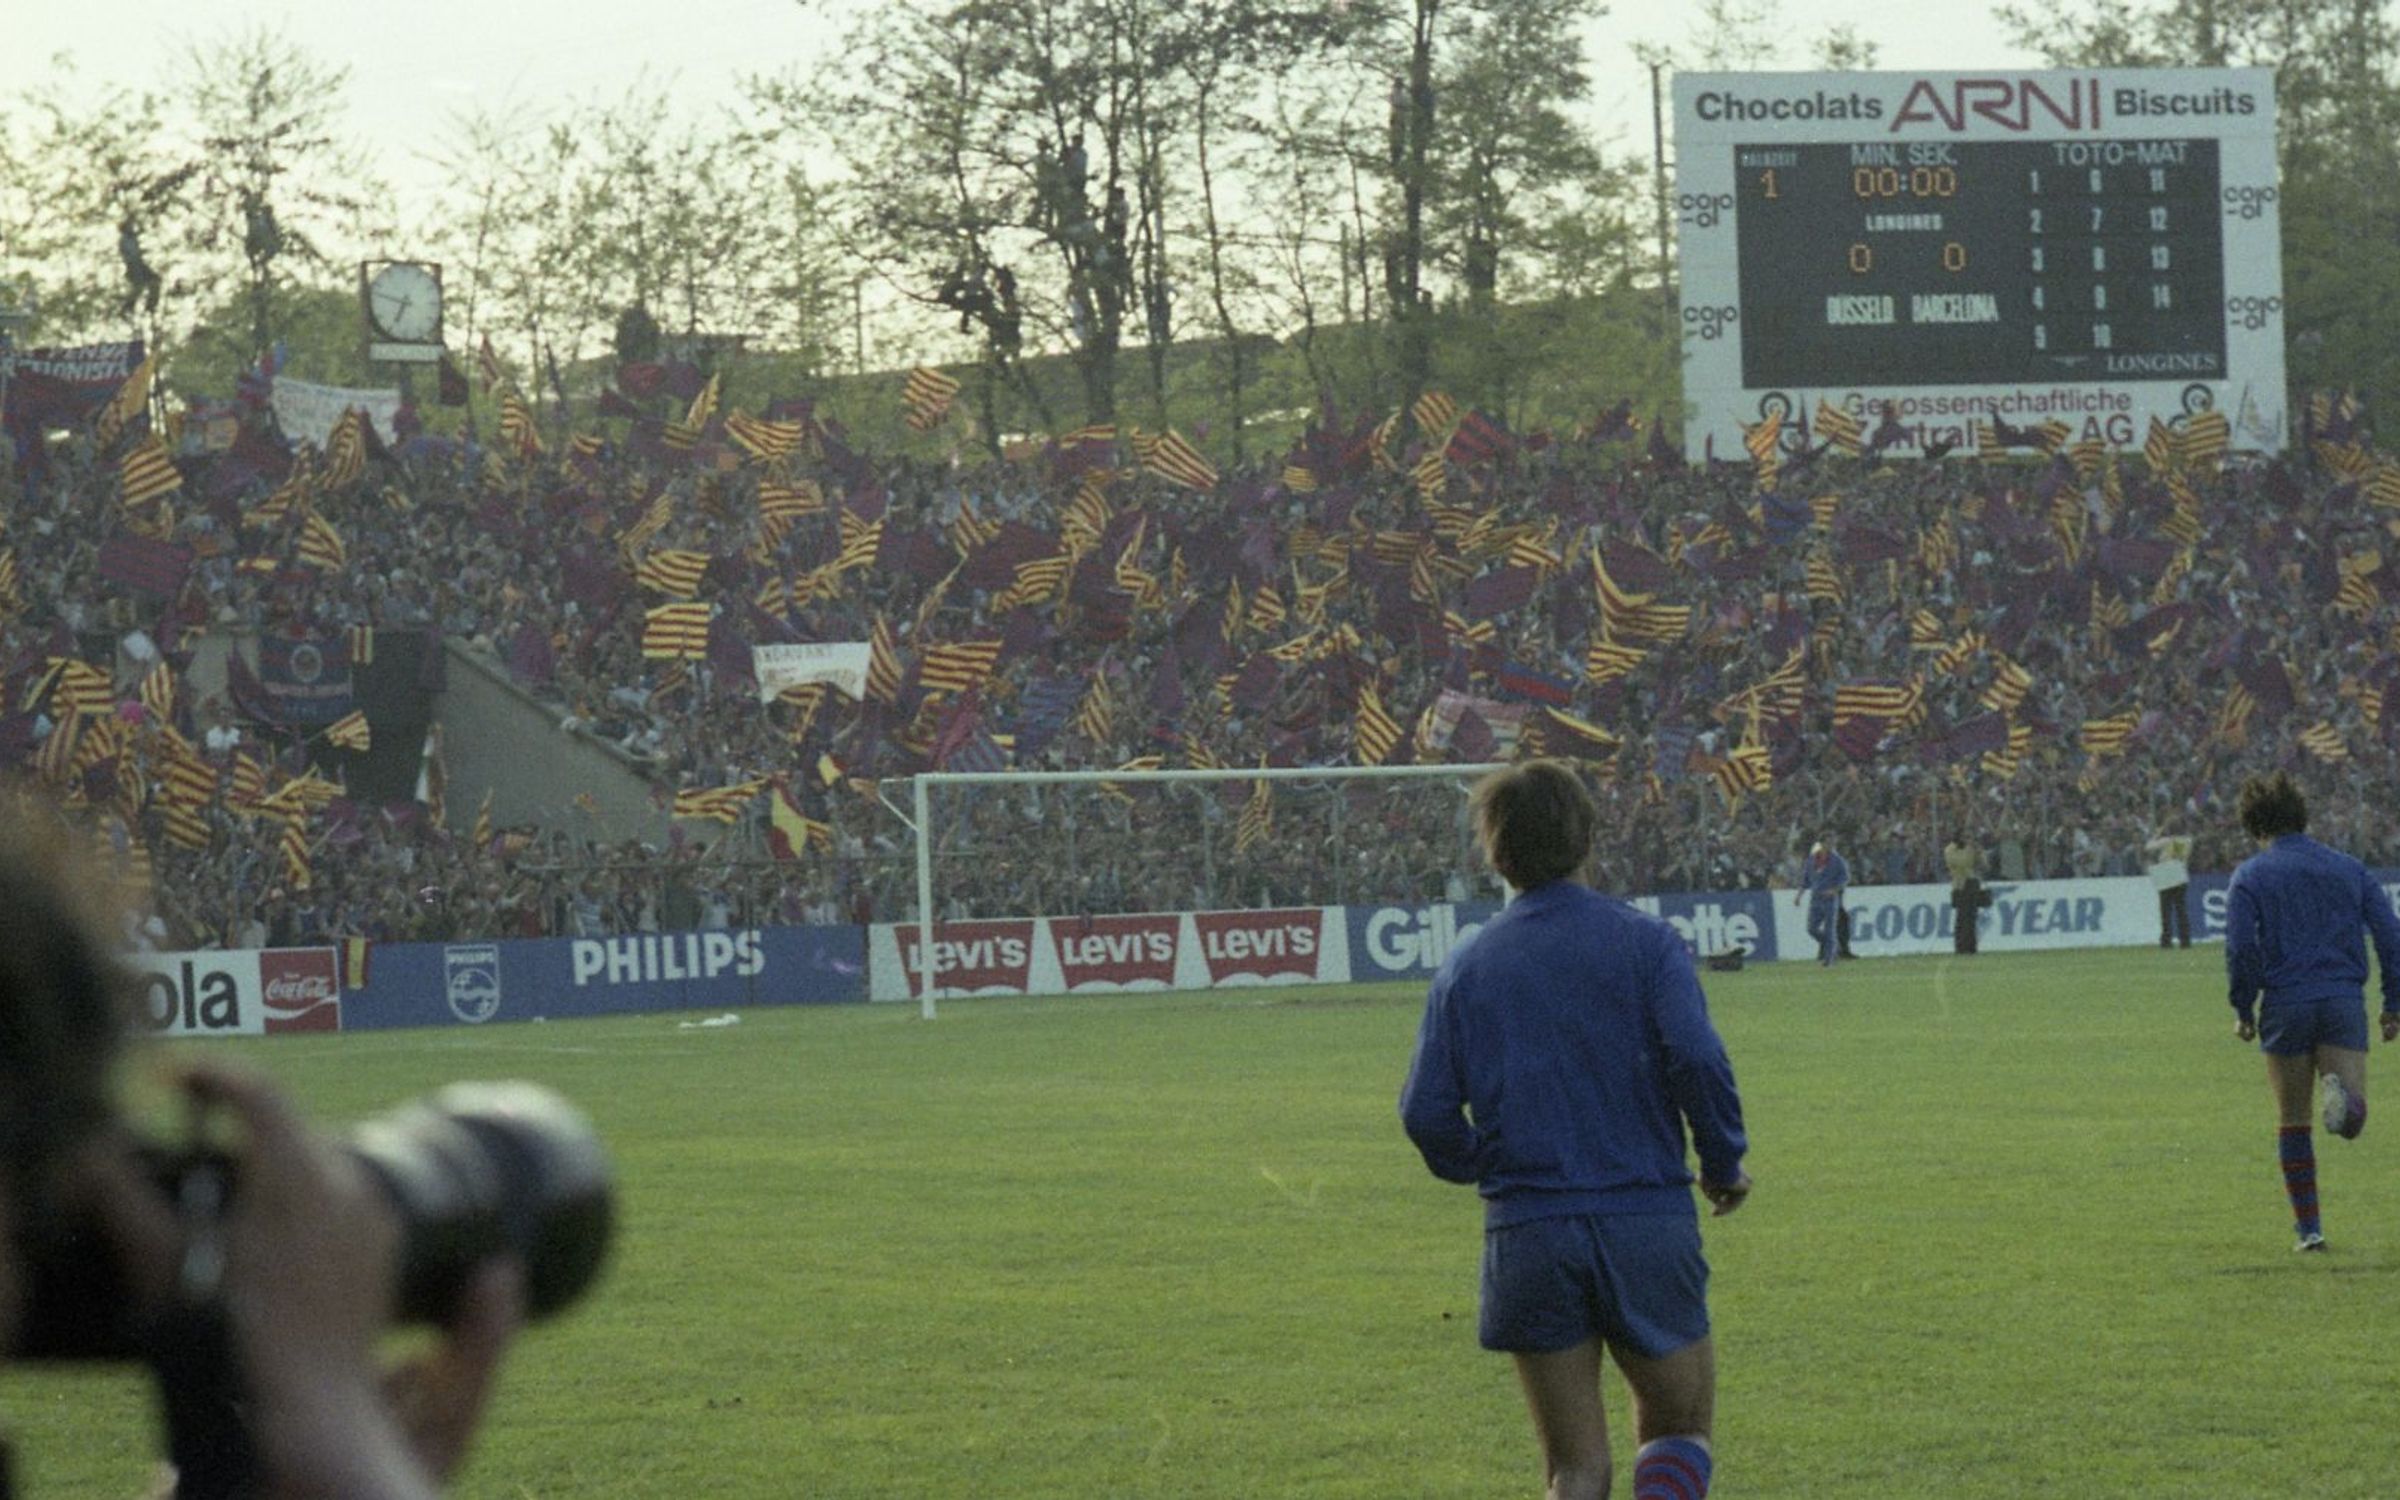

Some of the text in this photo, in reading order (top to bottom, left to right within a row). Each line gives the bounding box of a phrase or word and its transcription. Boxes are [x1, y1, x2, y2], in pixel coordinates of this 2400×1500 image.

[1695, 78, 2255, 132] Chocolats ARNI Biscuits
[1852, 143, 1958, 165] MIN. SEK.
[2053, 140, 2188, 165] TOTO-MAT
[1760, 169, 1778, 197] 1
[1854, 167, 1957, 196] 00:00
[2030, 170, 2039, 193] 1
[2030, 208, 2042, 233] 2
[2091, 207, 2103, 231] 7
[2150, 207, 2168, 231] 12
[1849, 242, 1966, 273] 0 0
[2032, 285, 2044, 311] 4
[2106, 353, 2219, 373] LONGINES
[1845, 387, 2132, 418] Geossenschaftliche
[2081, 413, 2134, 447] AG
[1998, 897, 2106, 937] YEAR
[571, 929, 766, 986] PHILIPS
